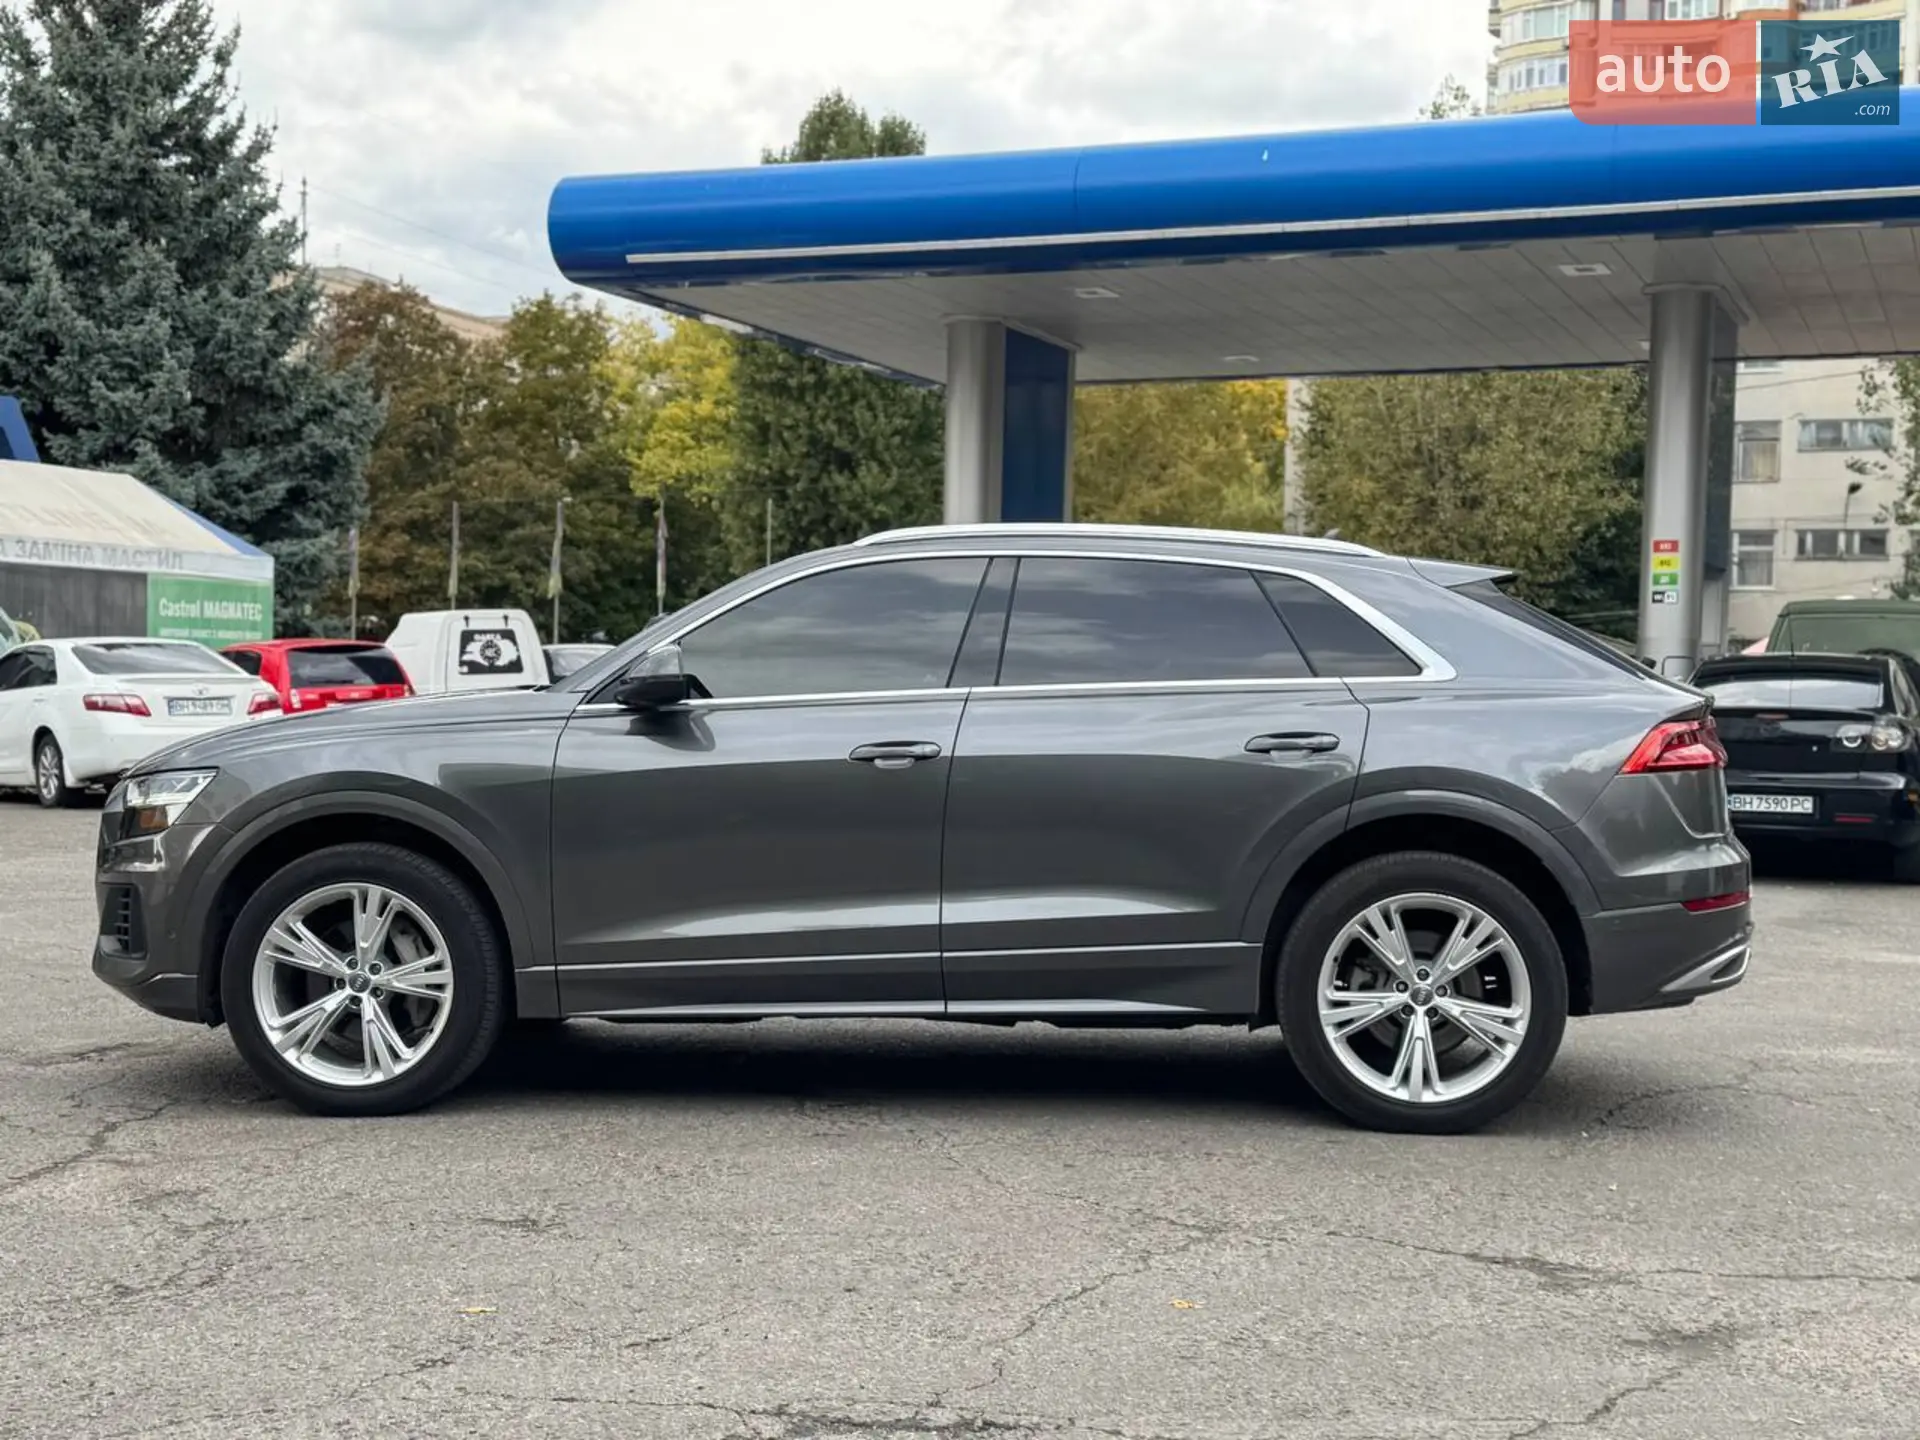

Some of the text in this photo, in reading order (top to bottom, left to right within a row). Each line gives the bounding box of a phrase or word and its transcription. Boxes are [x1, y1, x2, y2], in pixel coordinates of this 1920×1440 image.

[102, 546, 184, 571] МАСТИЛ
[158, 597, 263, 622] Castrol MAGNATEC
